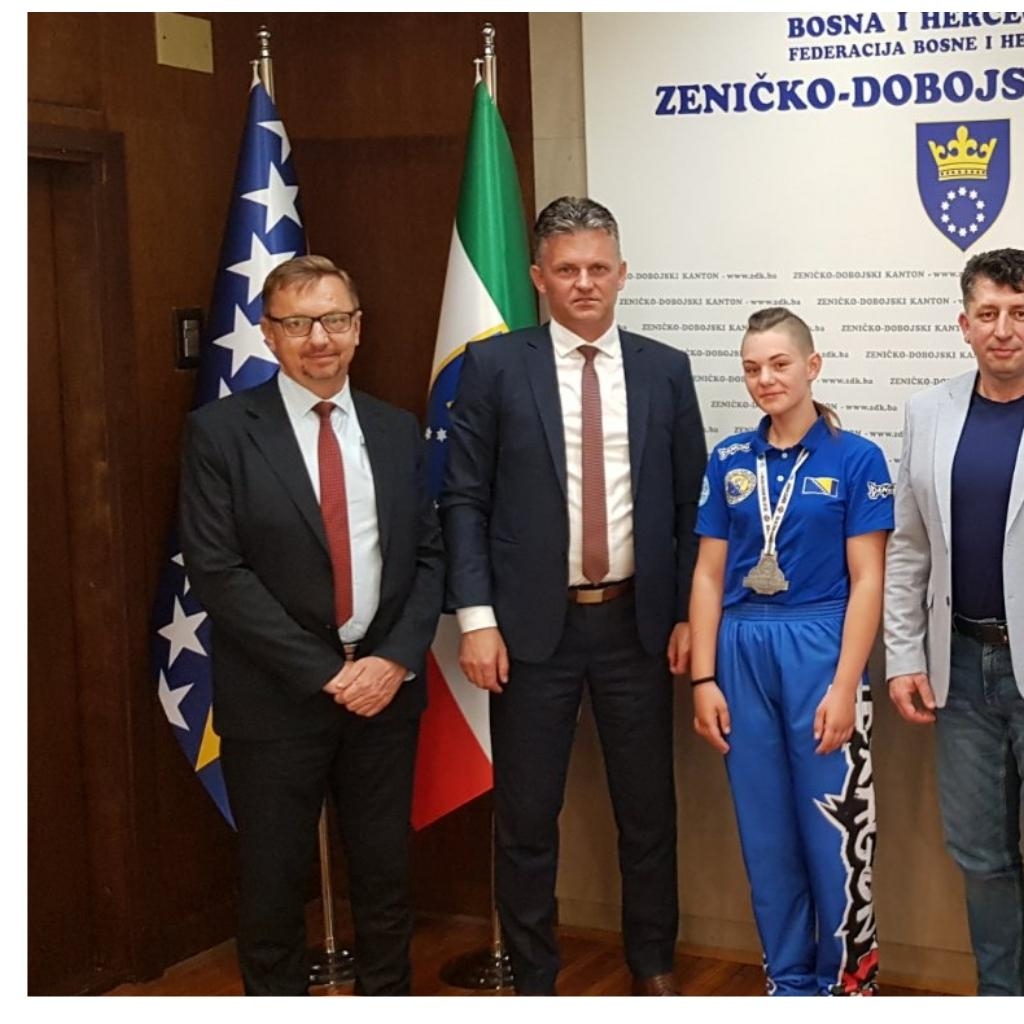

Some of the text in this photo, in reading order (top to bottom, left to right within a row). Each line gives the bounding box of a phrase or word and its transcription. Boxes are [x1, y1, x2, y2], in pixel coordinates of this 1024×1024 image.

[788, 13, 885, 38] BOSNA
[897, 12, 907, 31] I
[789, 42, 905, 61] FEDERACIJA
[914, 38, 977, 55] BOSNE
[985, 35, 992, 49] I
[682, 272, 719, 280] KANTON
[726, 272, 777, 280] www.zdk.ba
[793, 271, 882, 280] ZENIČKO-DOBOJSKI
[885, 270, 925, 279] KANTON
[705, 298, 743, 306] KANTON
[817, 297, 907, 306] ZENIČKO-DOBOJSKI
[910, 297, 949, 305] KANTON
[841, 324, 931, 333] ZENIČKO-DOBOJSKI
[865, 350, 956, 360] ZENIČKO-DOBOJSKI
[822, 377, 873, 386] www.zdk.ba
[845, 404, 898, 412] www.zdk.ba
